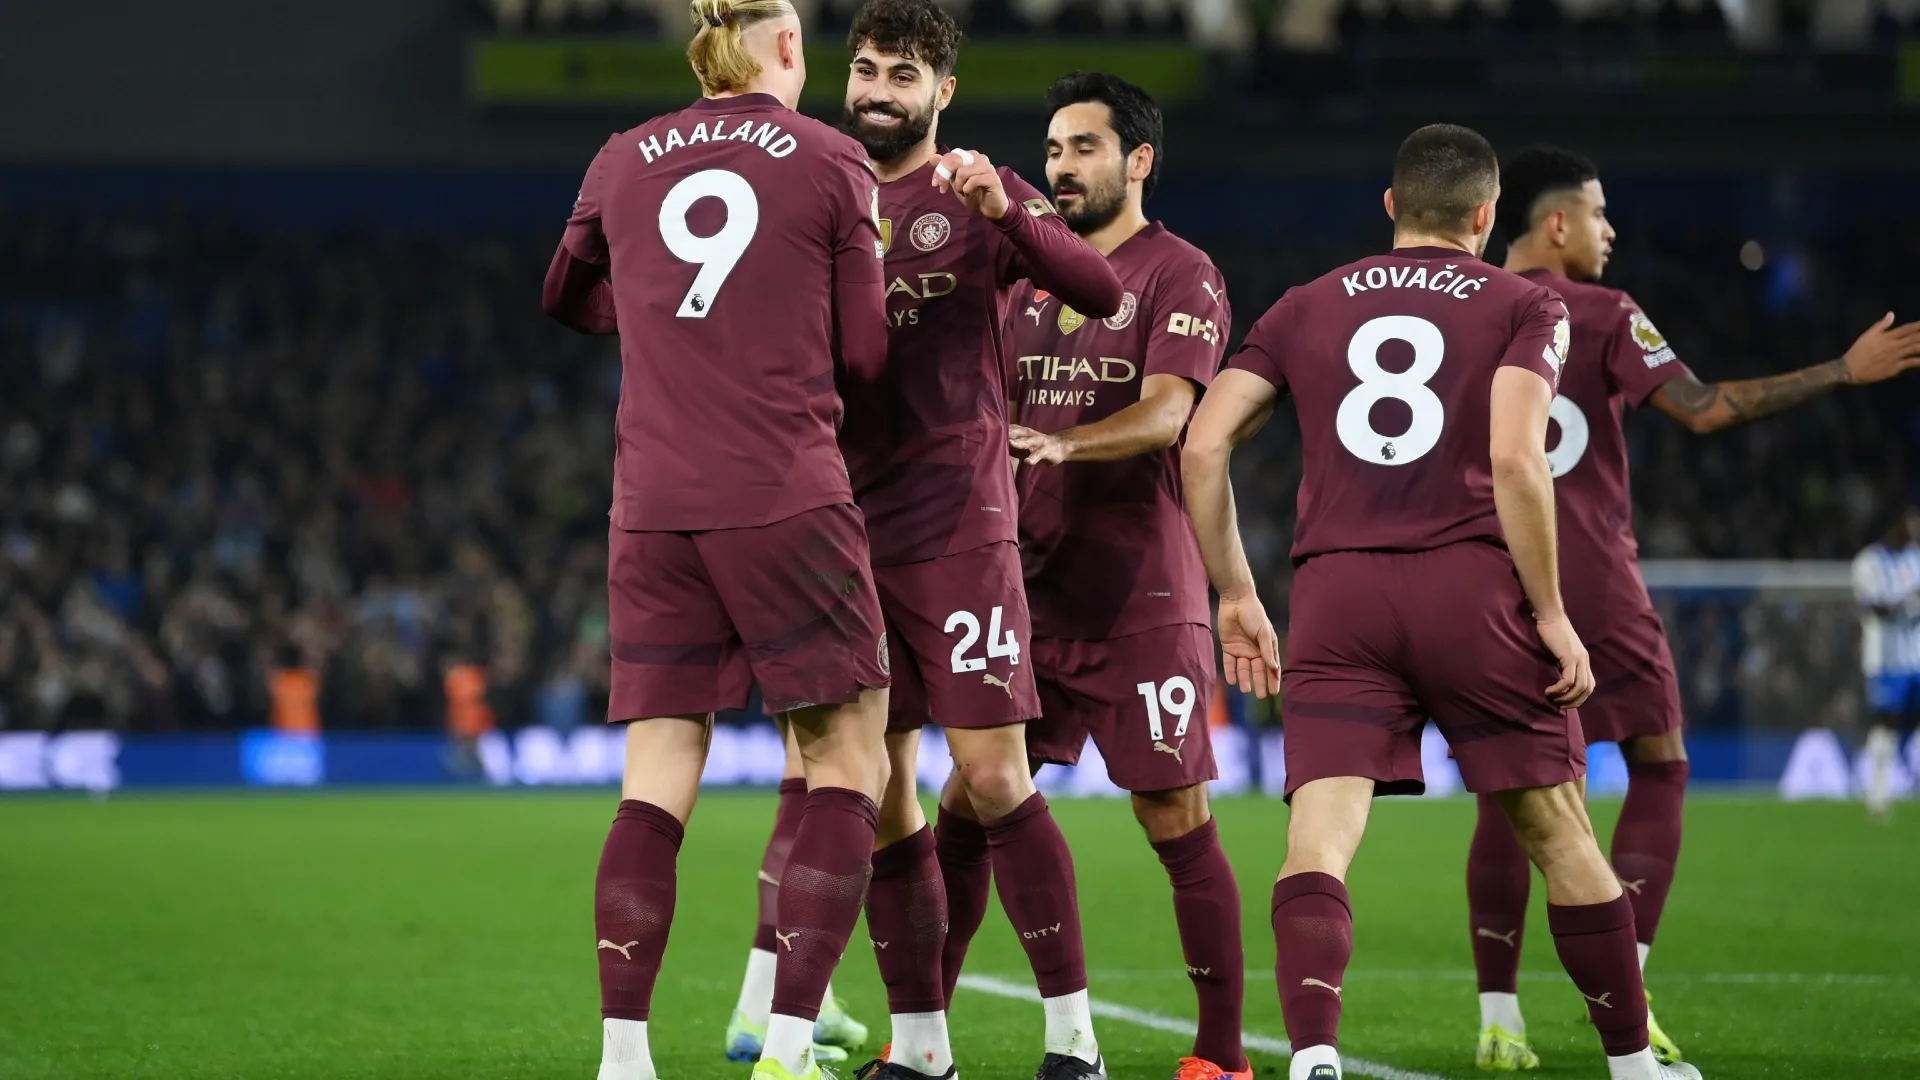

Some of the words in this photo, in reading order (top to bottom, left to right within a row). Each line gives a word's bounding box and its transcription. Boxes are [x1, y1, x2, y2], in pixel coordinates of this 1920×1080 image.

[638, 120, 798, 164] HAALAND
[658, 168, 760, 318] 9
[1341, 264, 1489, 300] KOVAČIĆ
[1167, 312, 1220, 347] OKX
[1336, 315, 1445, 466] 8
[943, 605, 1021, 675] 24
[1136, 675, 1197, 741] 19
[1315, 1068, 1334, 1076] KING
